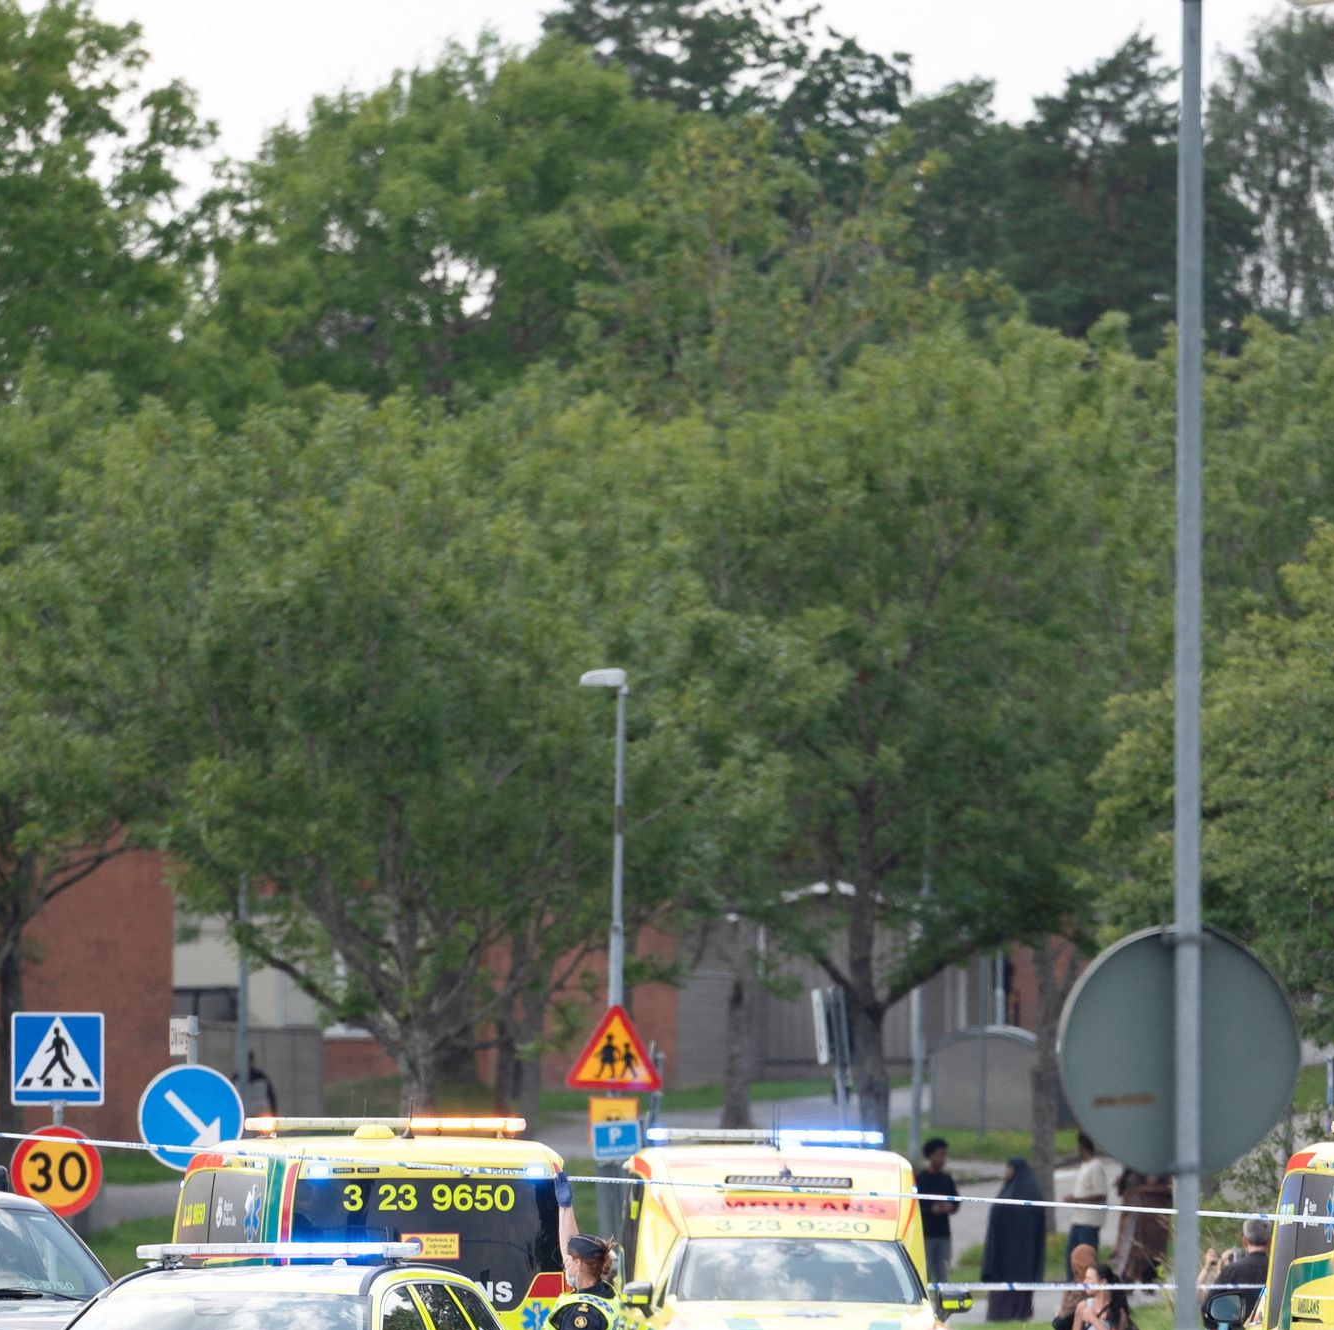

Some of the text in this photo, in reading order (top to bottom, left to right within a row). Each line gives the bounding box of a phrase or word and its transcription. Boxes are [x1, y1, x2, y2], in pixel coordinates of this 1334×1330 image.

[609, 1127, 622, 1145] P
[28, 1152, 88, 1195] 30
[343, 1183, 515, 1212] 3 23 9650
[716, 1219, 871, 1234] 3 23 9220
